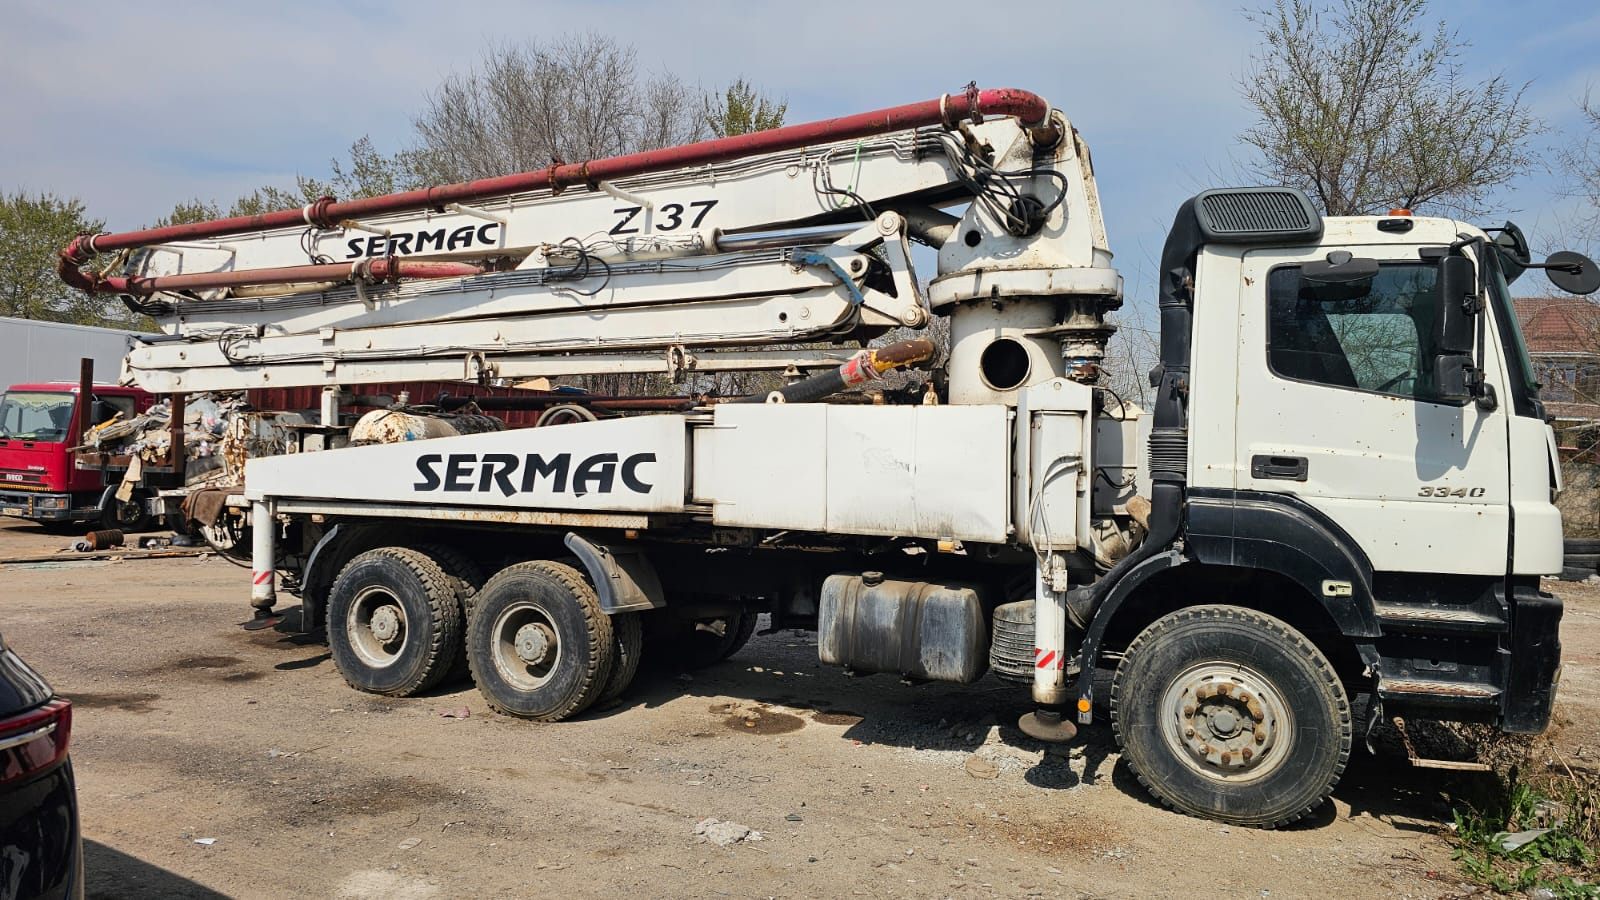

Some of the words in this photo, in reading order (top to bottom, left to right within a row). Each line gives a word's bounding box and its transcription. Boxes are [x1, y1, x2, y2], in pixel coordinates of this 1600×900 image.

[608, 206, 643, 235] Z
[656, 200, 719, 231] 37
[346, 222, 499, 259] SERMAC
[413, 453, 657, 498] SERMAC
